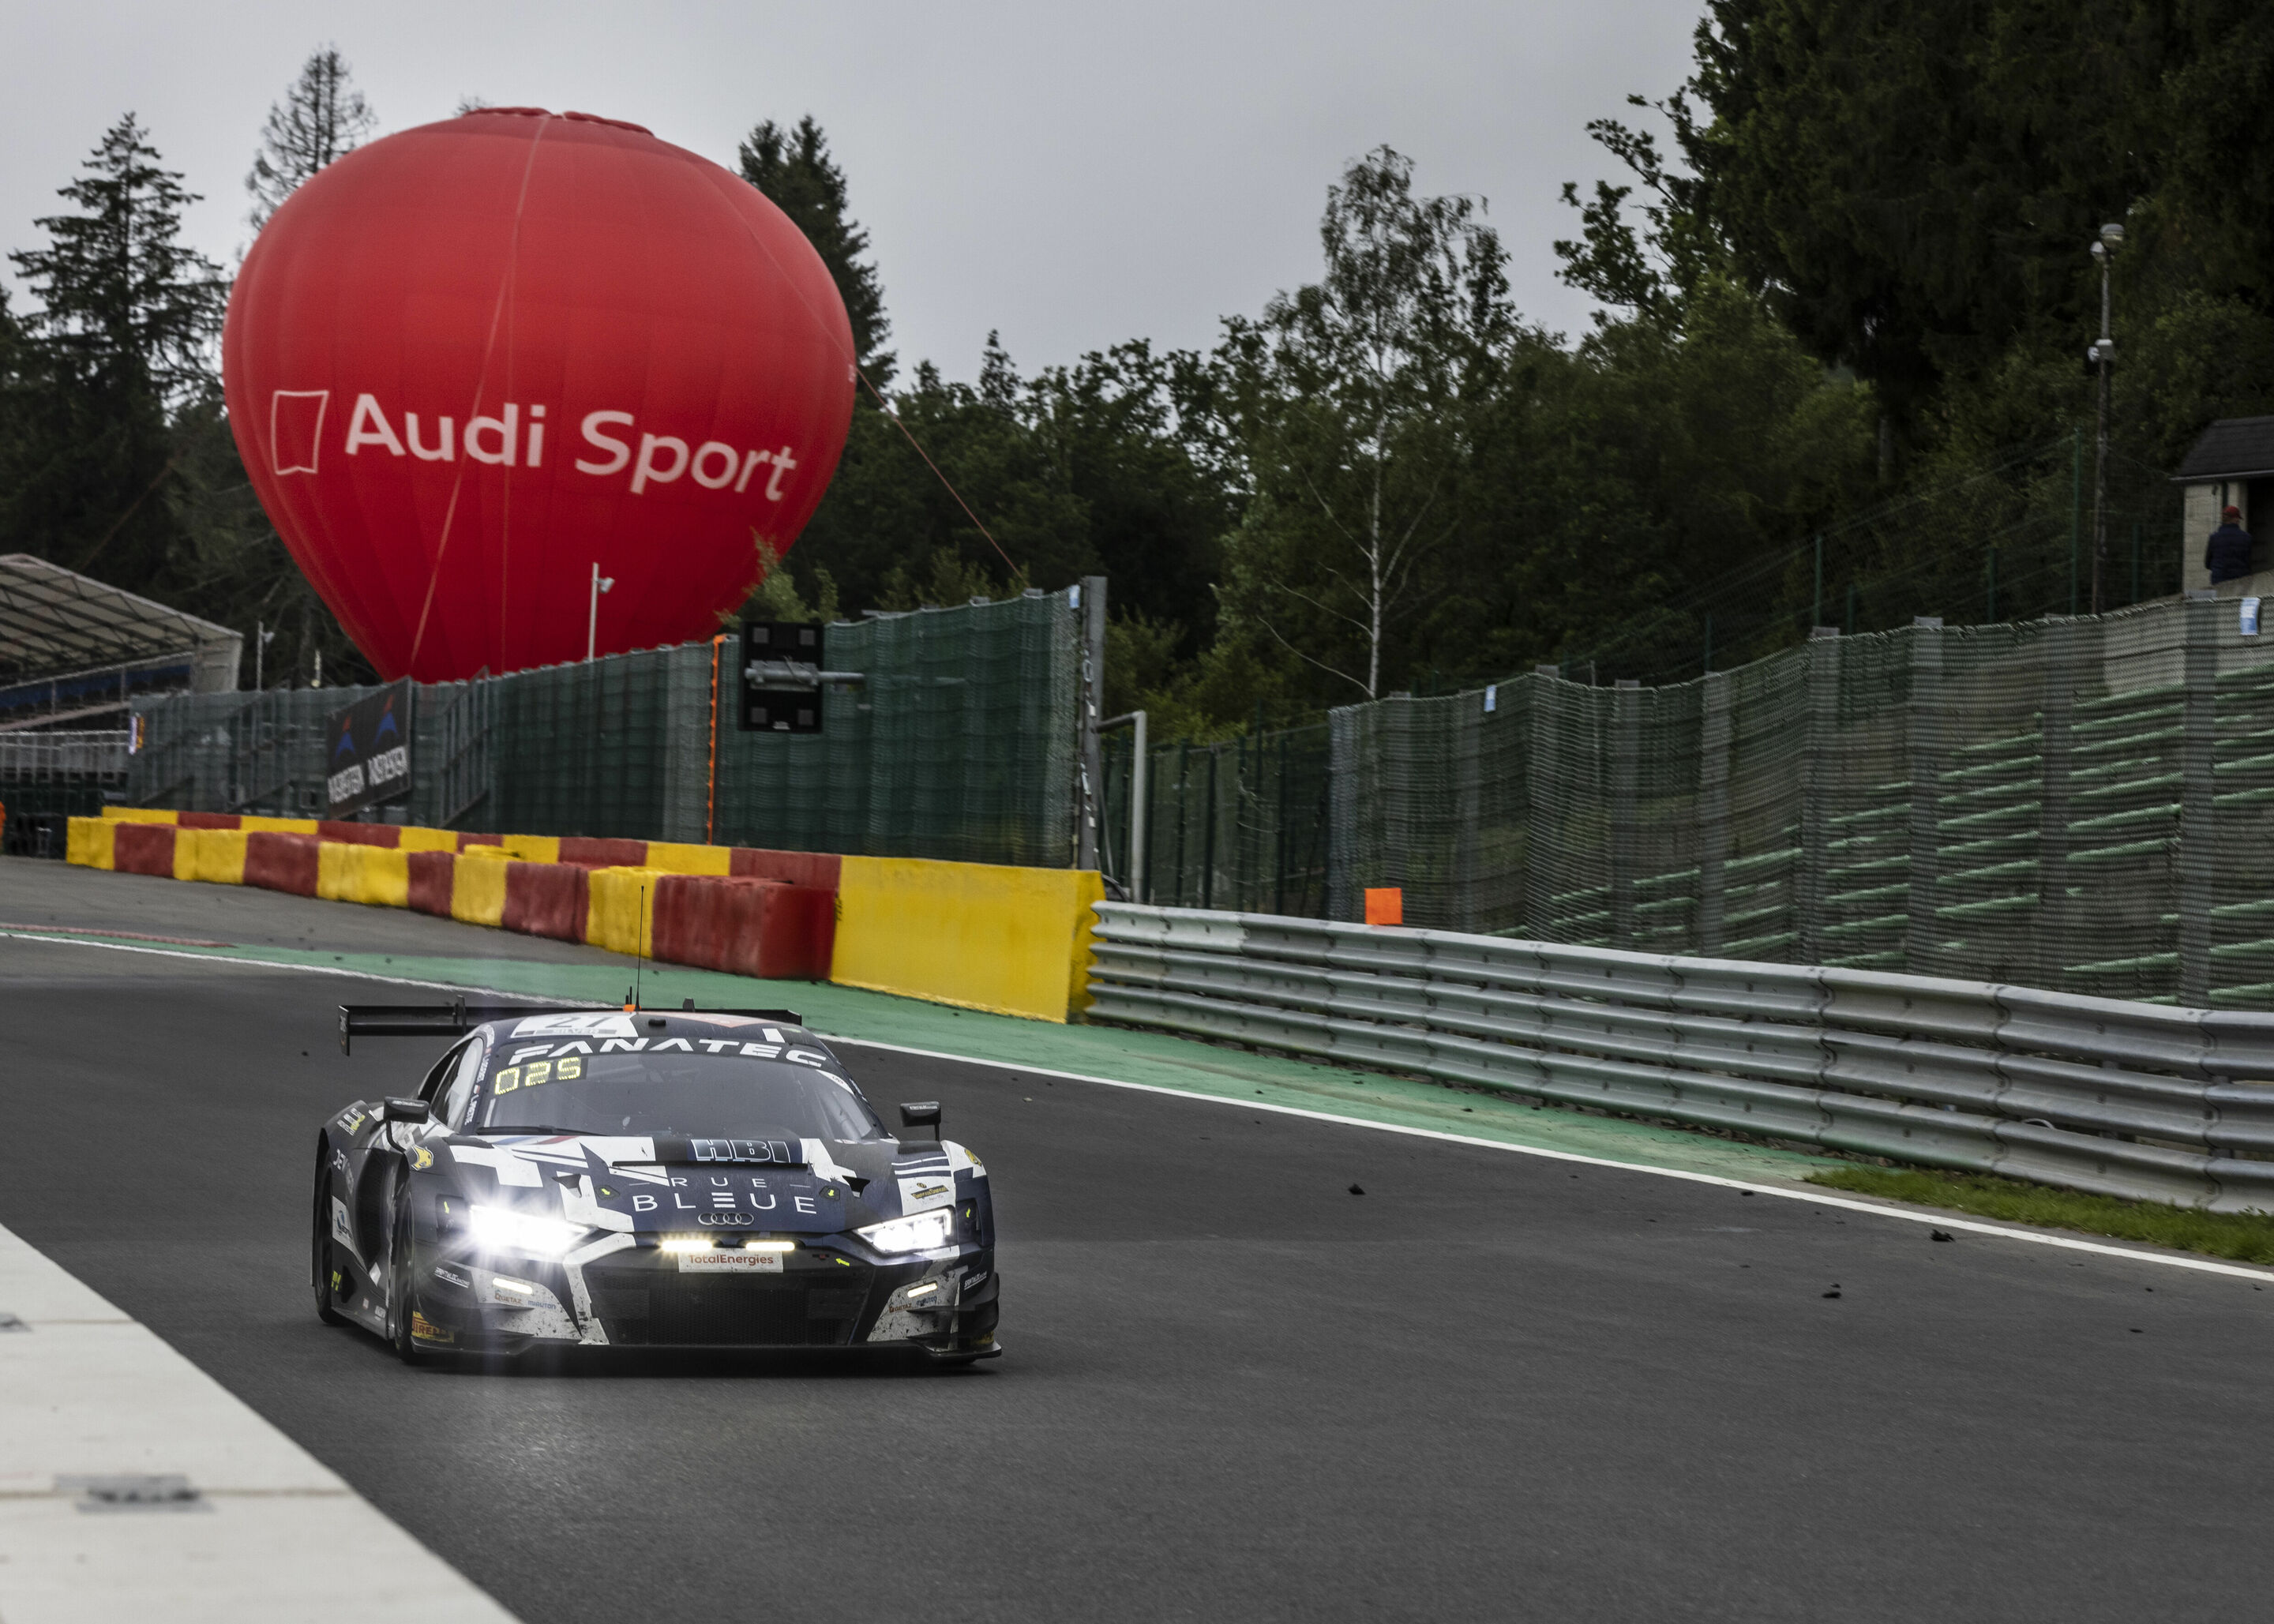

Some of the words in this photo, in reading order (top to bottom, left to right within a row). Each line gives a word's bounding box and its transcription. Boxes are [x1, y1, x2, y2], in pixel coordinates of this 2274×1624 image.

[345, 393, 546, 467] Audi
[574, 409, 797, 501] Sport
[508, 1037, 827, 1067] FANATEC
[495, 1056, 581, 1095] 025
[691, 1138, 791, 1163] HBI
[671, 1177, 767, 1188] RUE
[689, 1254, 774, 1266] TotalEnergies
